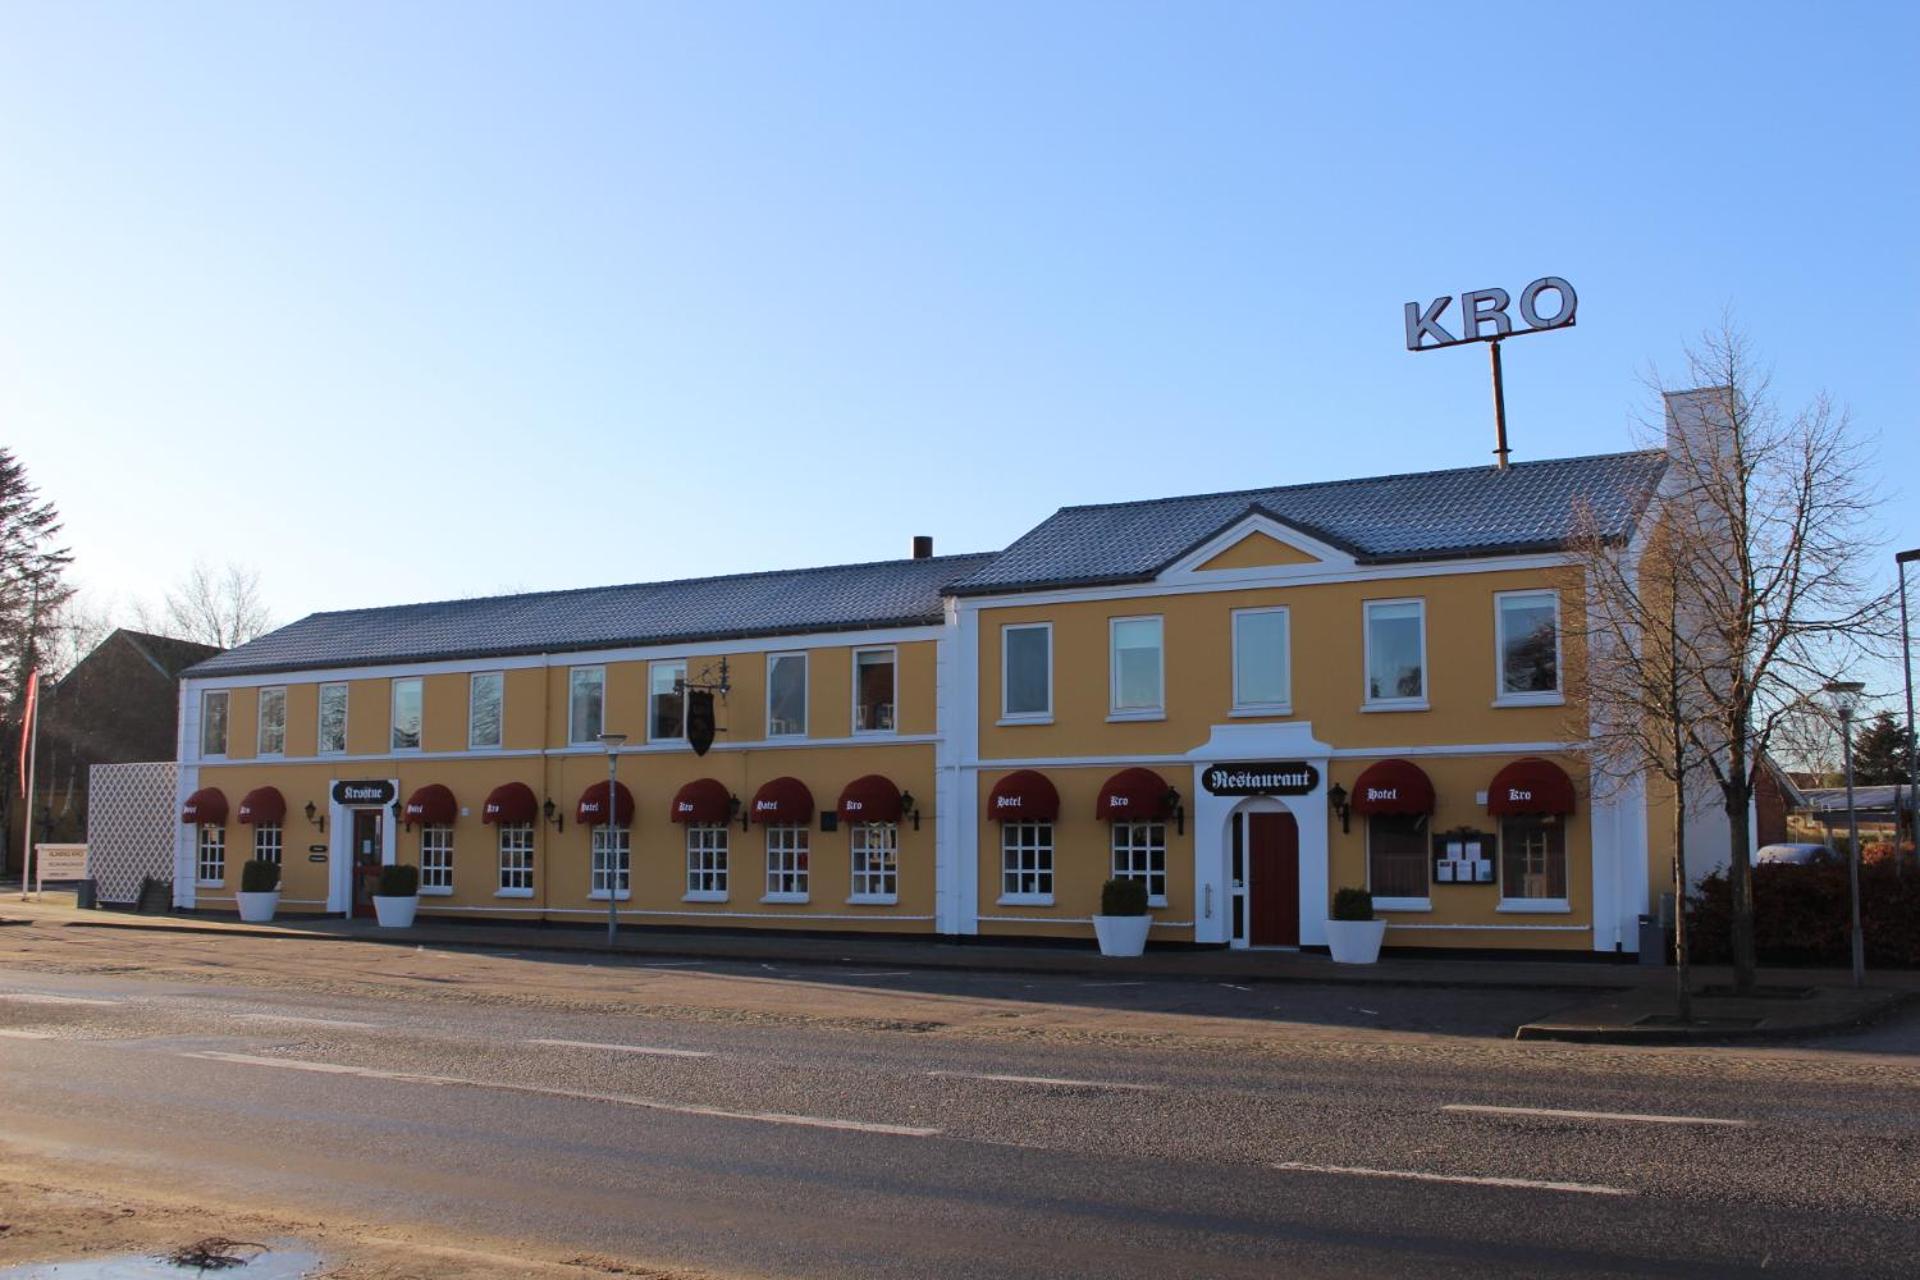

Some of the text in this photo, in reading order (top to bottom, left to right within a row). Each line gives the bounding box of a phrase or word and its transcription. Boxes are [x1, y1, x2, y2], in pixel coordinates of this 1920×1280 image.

[1404, 276, 1577, 349] KRO
[1211, 769, 1310, 788] Restaurant
[1367, 788, 1396, 802] Hotel
[1509, 788, 1531, 801] Kro
[846, 800, 862, 810] Kro
[997, 796, 1021, 807] Hotel
[1110, 796, 1128, 807] Kro
